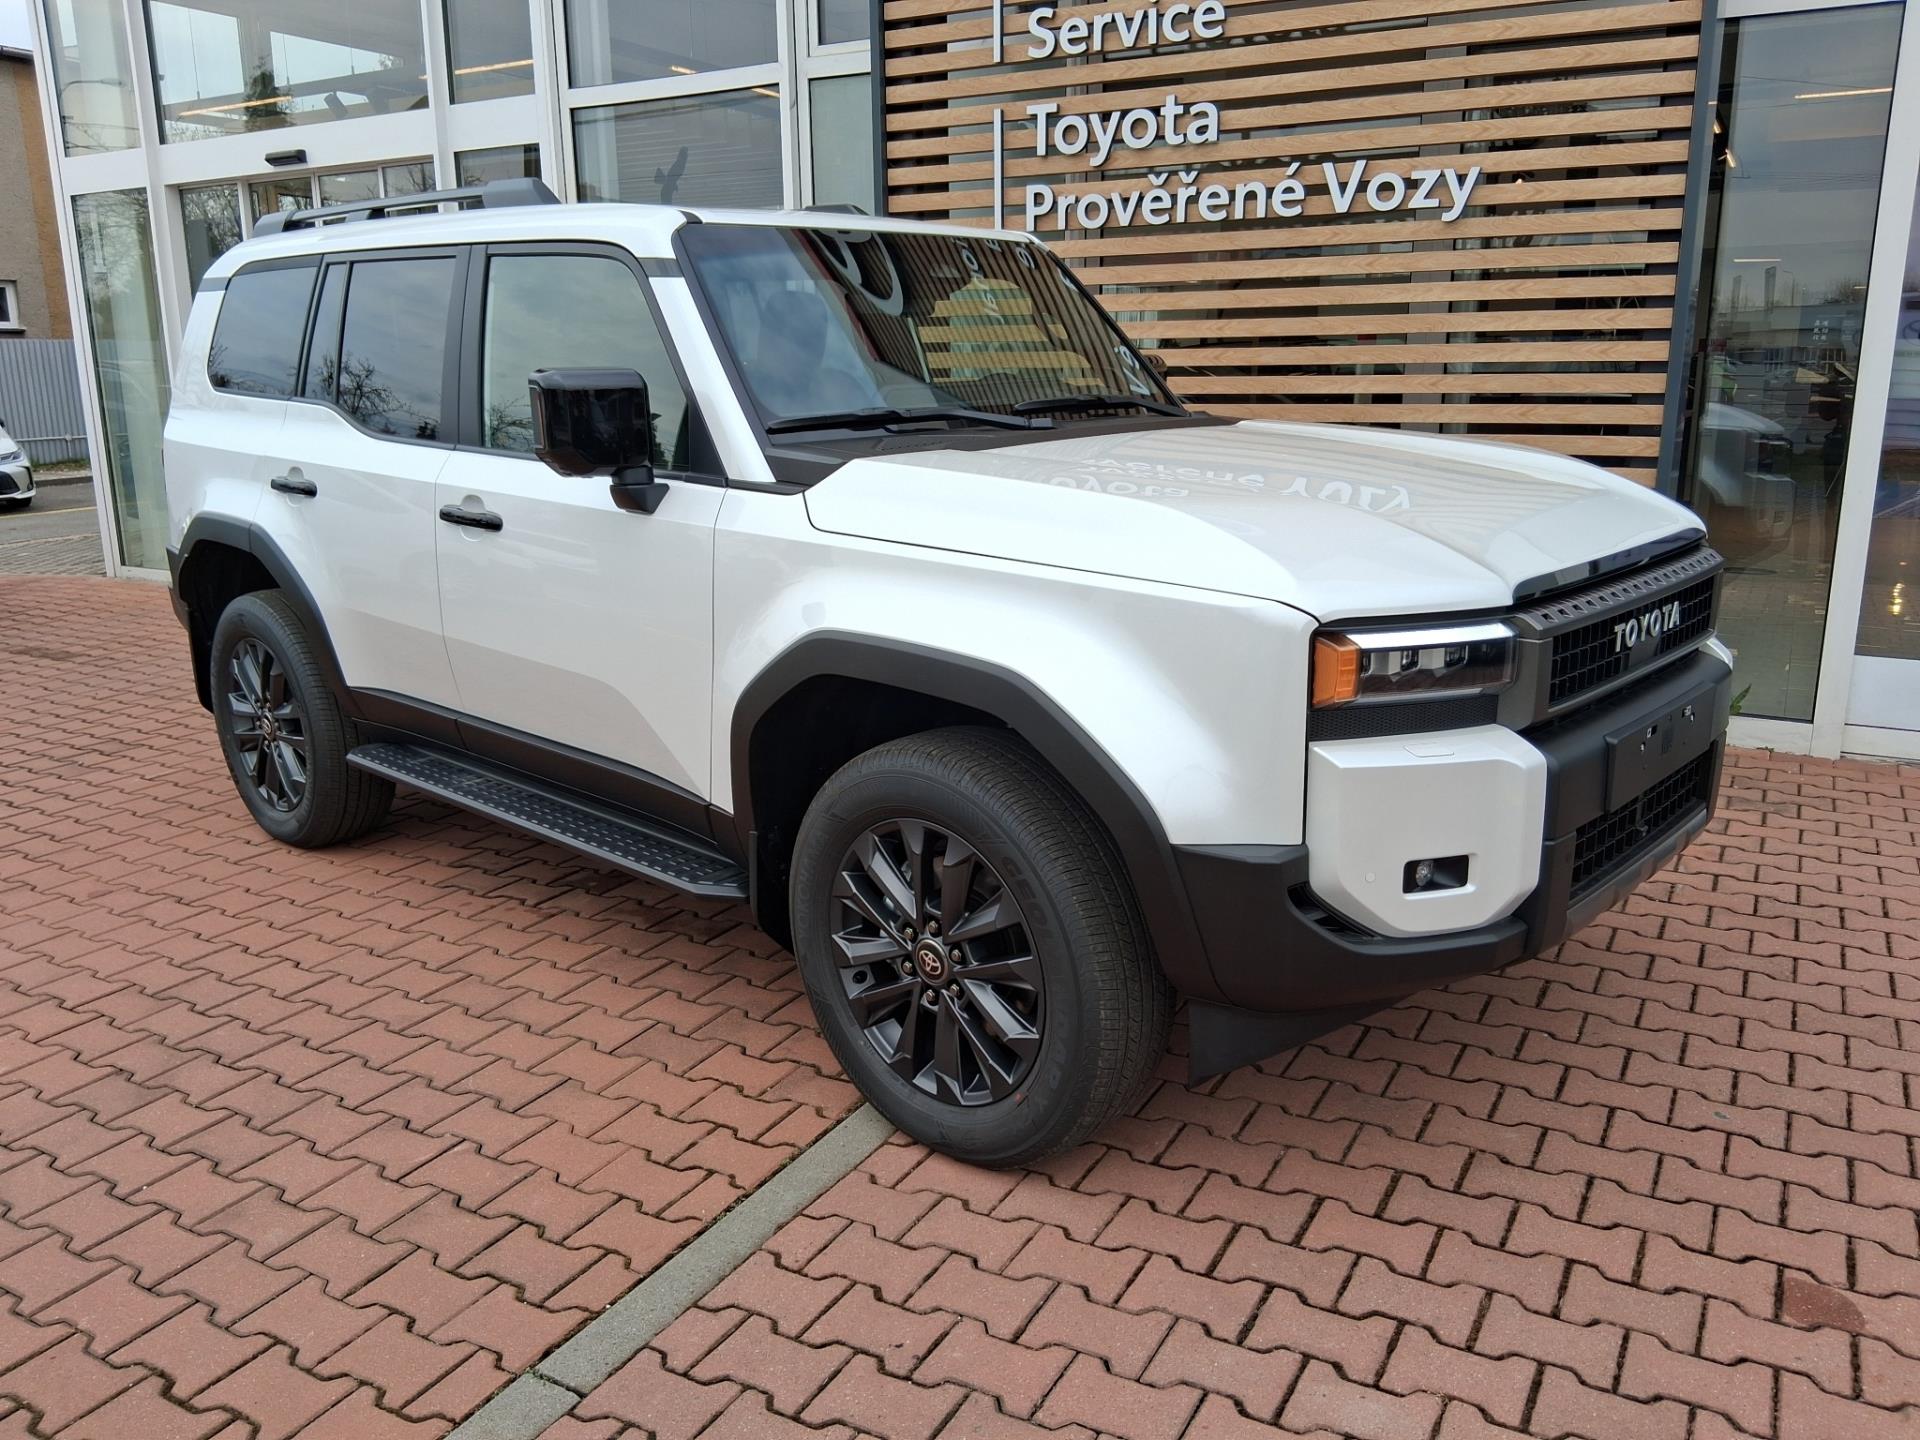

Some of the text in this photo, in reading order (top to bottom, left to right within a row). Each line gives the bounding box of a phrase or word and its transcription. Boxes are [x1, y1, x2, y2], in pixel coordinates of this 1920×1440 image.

[1027, 0, 1226, 59] Service
[1026, 94, 1220, 167] Toyota
[1025, 160, 1480, 231] Prověřené Vozy
[1614, 601, 1680, 653] TOYOTA
